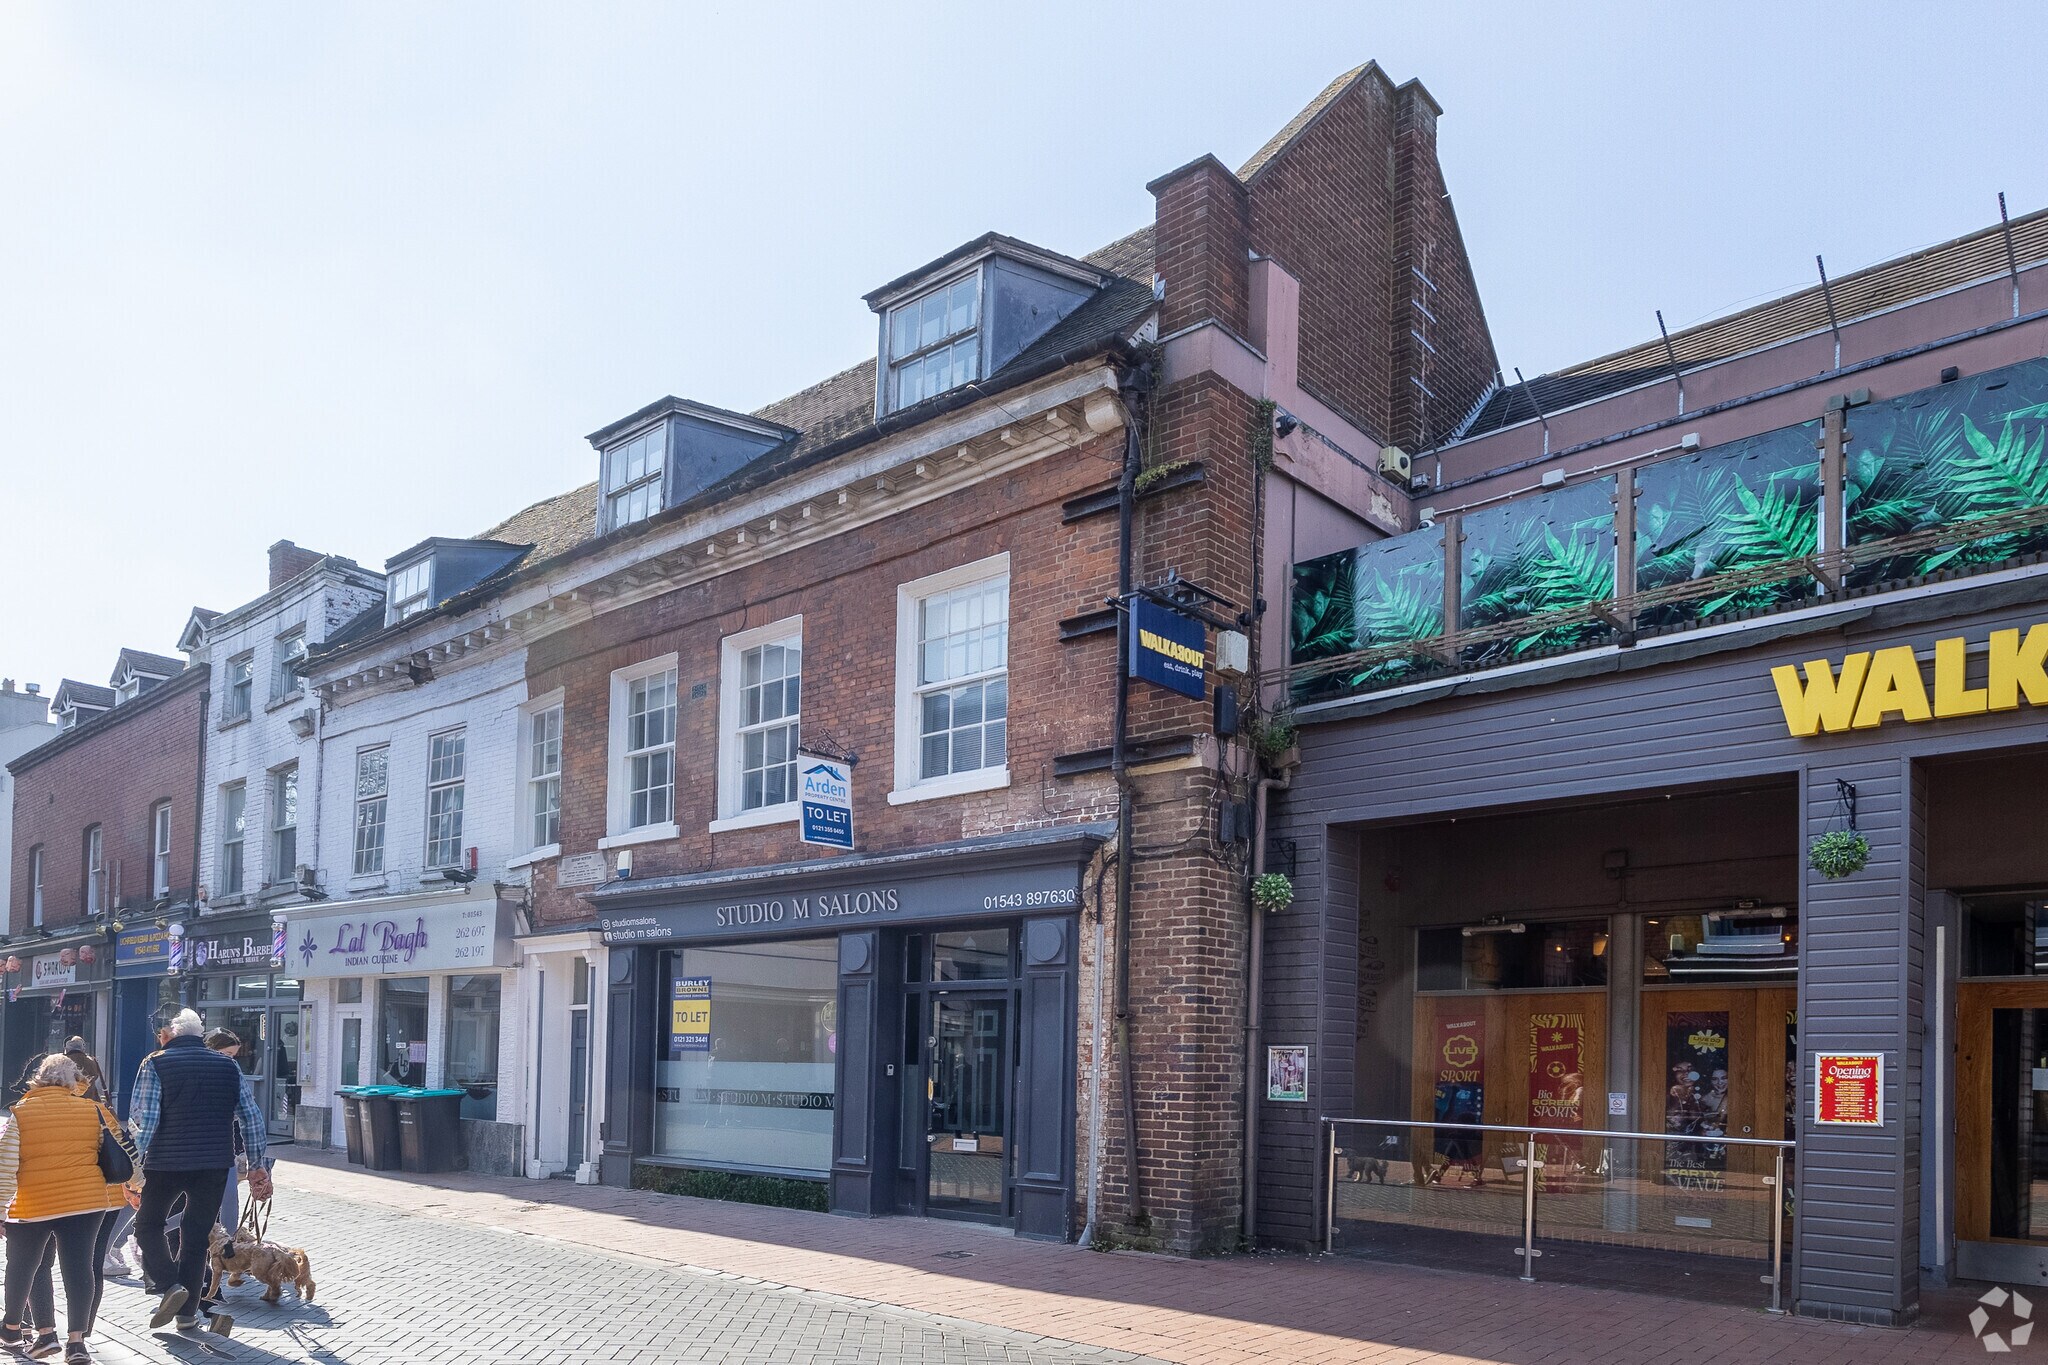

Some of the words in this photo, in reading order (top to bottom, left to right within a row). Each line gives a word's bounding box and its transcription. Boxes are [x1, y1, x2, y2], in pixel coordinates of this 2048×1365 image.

[1140, 629, 1204, 669] WALKABOUT
[1174, 664, 1191, 676] drink,
[1191, 669, 1203, 679] play
[1770, 623, 2048, 738] WALK
[805, 776, 846, 798] Arden
[805, 791, 829, 801] PROPERTY
[806, 806, 823, 819] TO
[826, 809, 847, 824] LET
[984, 893, 1022, 910] 01543
[1026, 888, 1075, 906] 897630
[716, 901, 783, 927] STUDIO
[793, 899, 809, 920] M
[818, 889, 898, 917] SALONS
[611, 917, 660, 928] studiomsalons_
[455, 928, 470, 938] 262
[471, 925, 486, 937] 697
[613, 929, 635, 940] studio
[637, 930, 645, 938] m
[646, 926, 671, 938] salons
[328, 922, 367, 953] Lal
[373, 916, 428, 963] Bagh
[455, 947, 469, 958] 262
[471, 945, 485, 957] 197
[345, 956, 368, 966] INDIAN
[371, 954, 398, 965] CUISINE
[676, 1012, 688, 1023] TO
[690, 1011, 708, 1023] LET
[1446, 1021, 1476, 1029] WALKABOUT
[1447, 1046, 1475, 1054] LIVE
[1541, 1043, 1574, 1051] WALKABOUT
[1440, 1070, 1481, 1082] SPORT
[1829, 1065, 1872, 1078] Opening
[1533, 1105, 1578, 1118] SPORTS
[1669, 1159, 1684, 1168] The
[1687, 1160, 1706, 1169] Best
[1669, 1169, 1720, 1178] PARTY
[1678, 1177, 1726, 1192] VENUE
